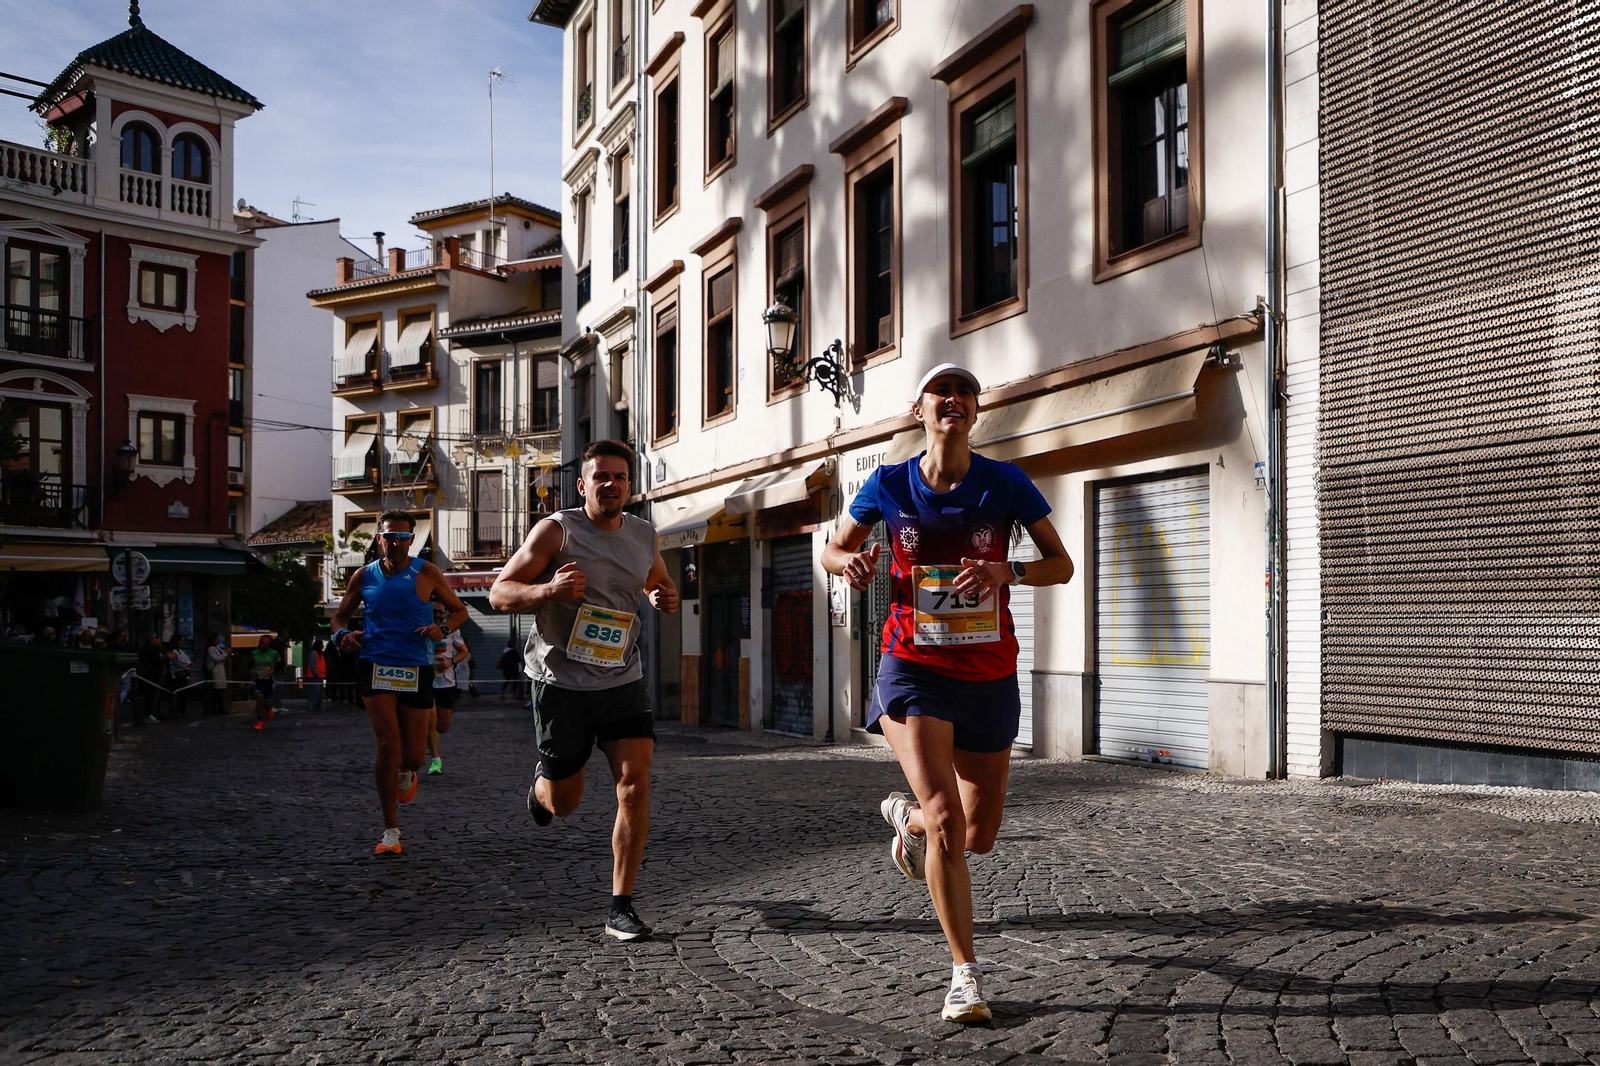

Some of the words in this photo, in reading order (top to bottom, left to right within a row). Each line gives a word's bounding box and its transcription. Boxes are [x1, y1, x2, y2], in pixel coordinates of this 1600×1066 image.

[848, 479, 867, 495] DA
[680, 533, 686, 545] LA
[931, 589, 980, 610] 713
[584, 623, 622, 644] 838
[377, 667, 414, 680] 1459
